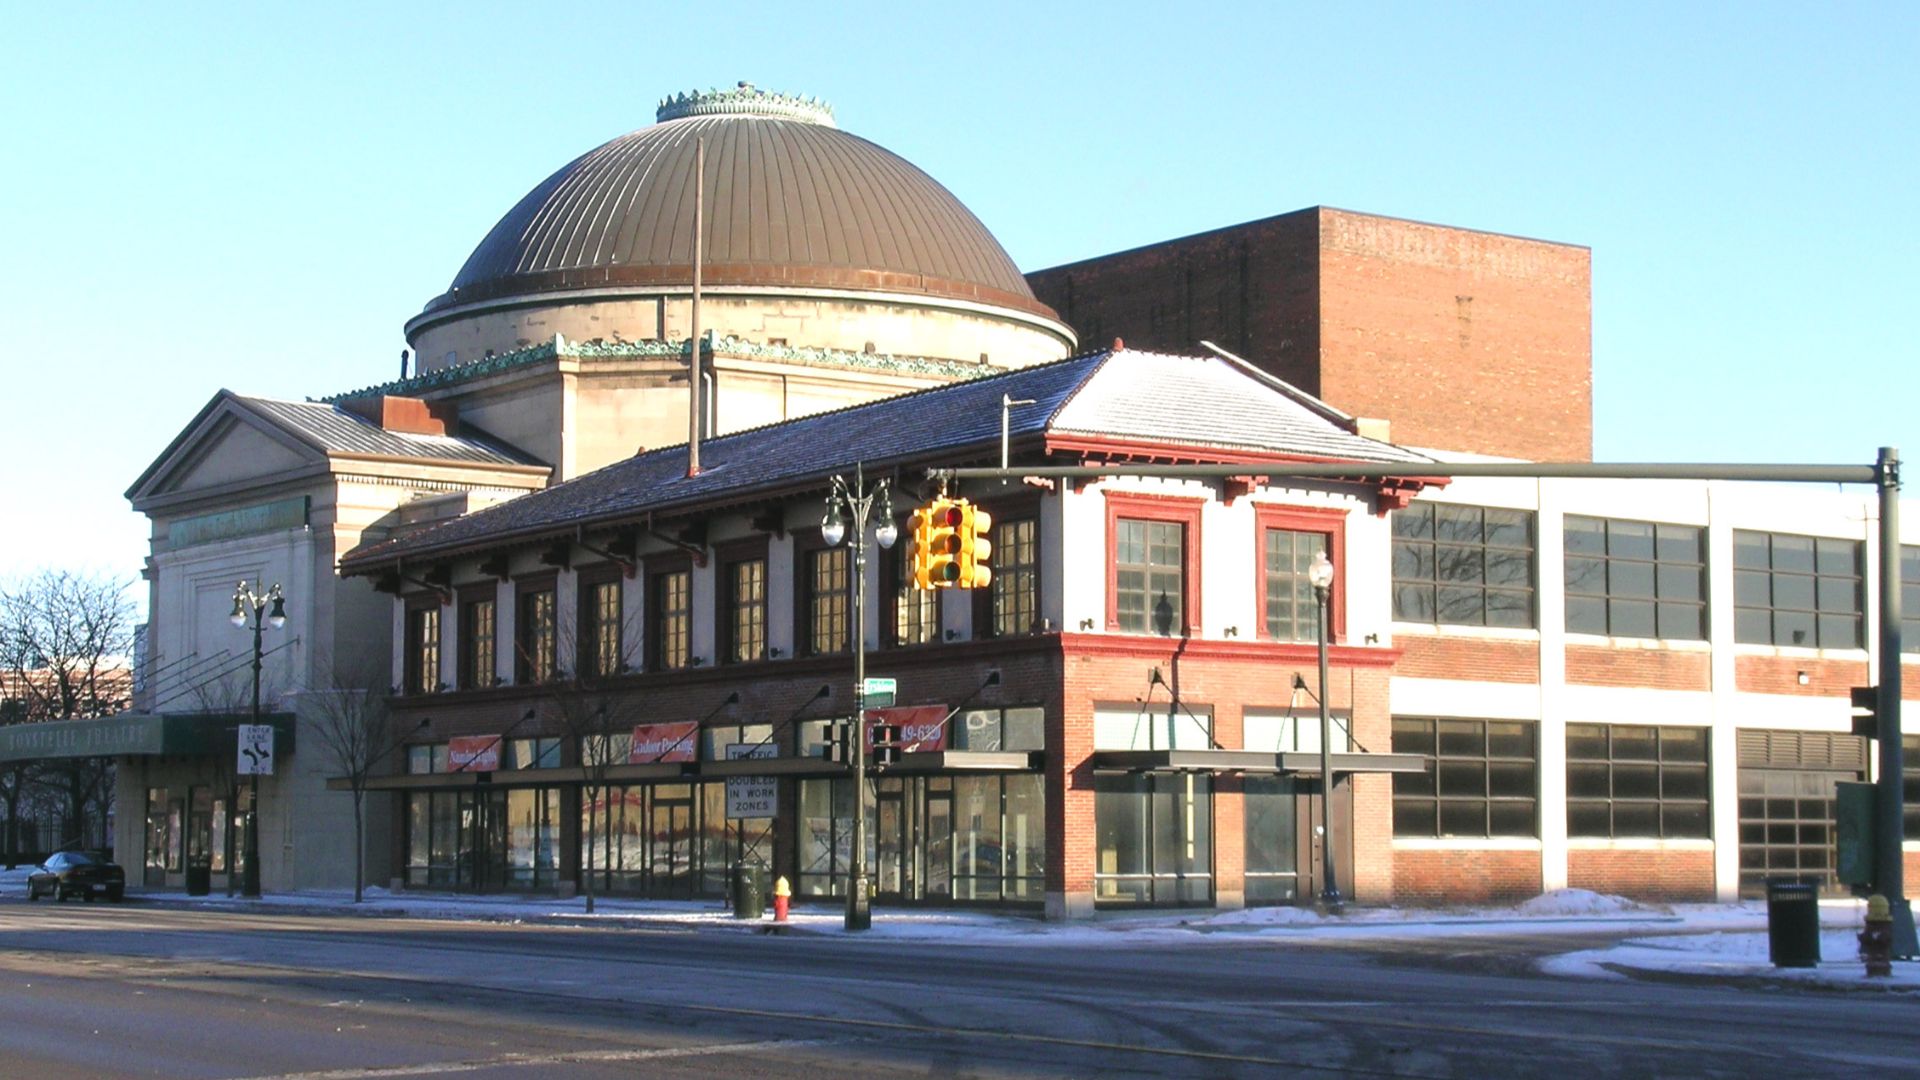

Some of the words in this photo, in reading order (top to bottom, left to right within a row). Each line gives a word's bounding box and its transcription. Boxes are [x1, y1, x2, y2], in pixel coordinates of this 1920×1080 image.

[732, 750, 773, 761] TRFFIC
[729, 775, 776, 785] DOUBLED
[729, 789, 740, 799] IN
[747, 788, 775, 799] WORK
[735, 802, 769, 812] ZONES
